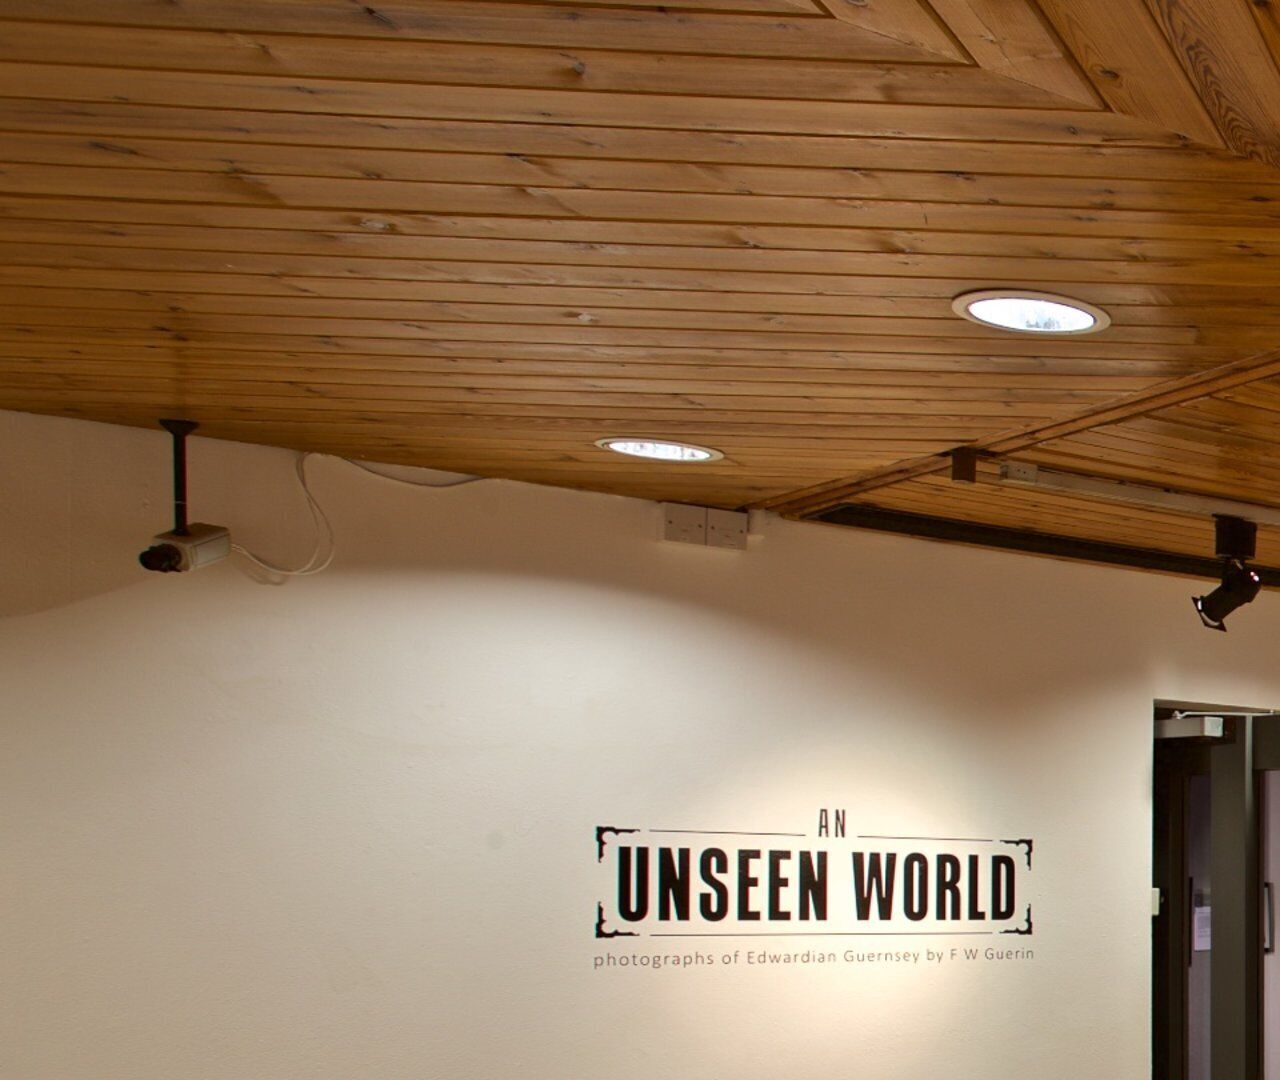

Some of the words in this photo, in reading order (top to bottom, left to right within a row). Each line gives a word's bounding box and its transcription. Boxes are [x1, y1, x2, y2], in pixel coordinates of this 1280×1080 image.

[819, 808, 846, 838] AN
[617, 846, 828, 922] UNSEEN
[852, 852, 1016, 922] WORLD
[594, 952, 714, 969] photographs
[722, 950, 740, 965] of
[747, 950, 836, 965] Edwardian
[844, 949, 920, 964] Guernsey
[926, 949, 944, 963] by
[951, 949, 957, 961] F
[964, 949, 978, 960] W
[985, 947, 1034, 960] Guerin
